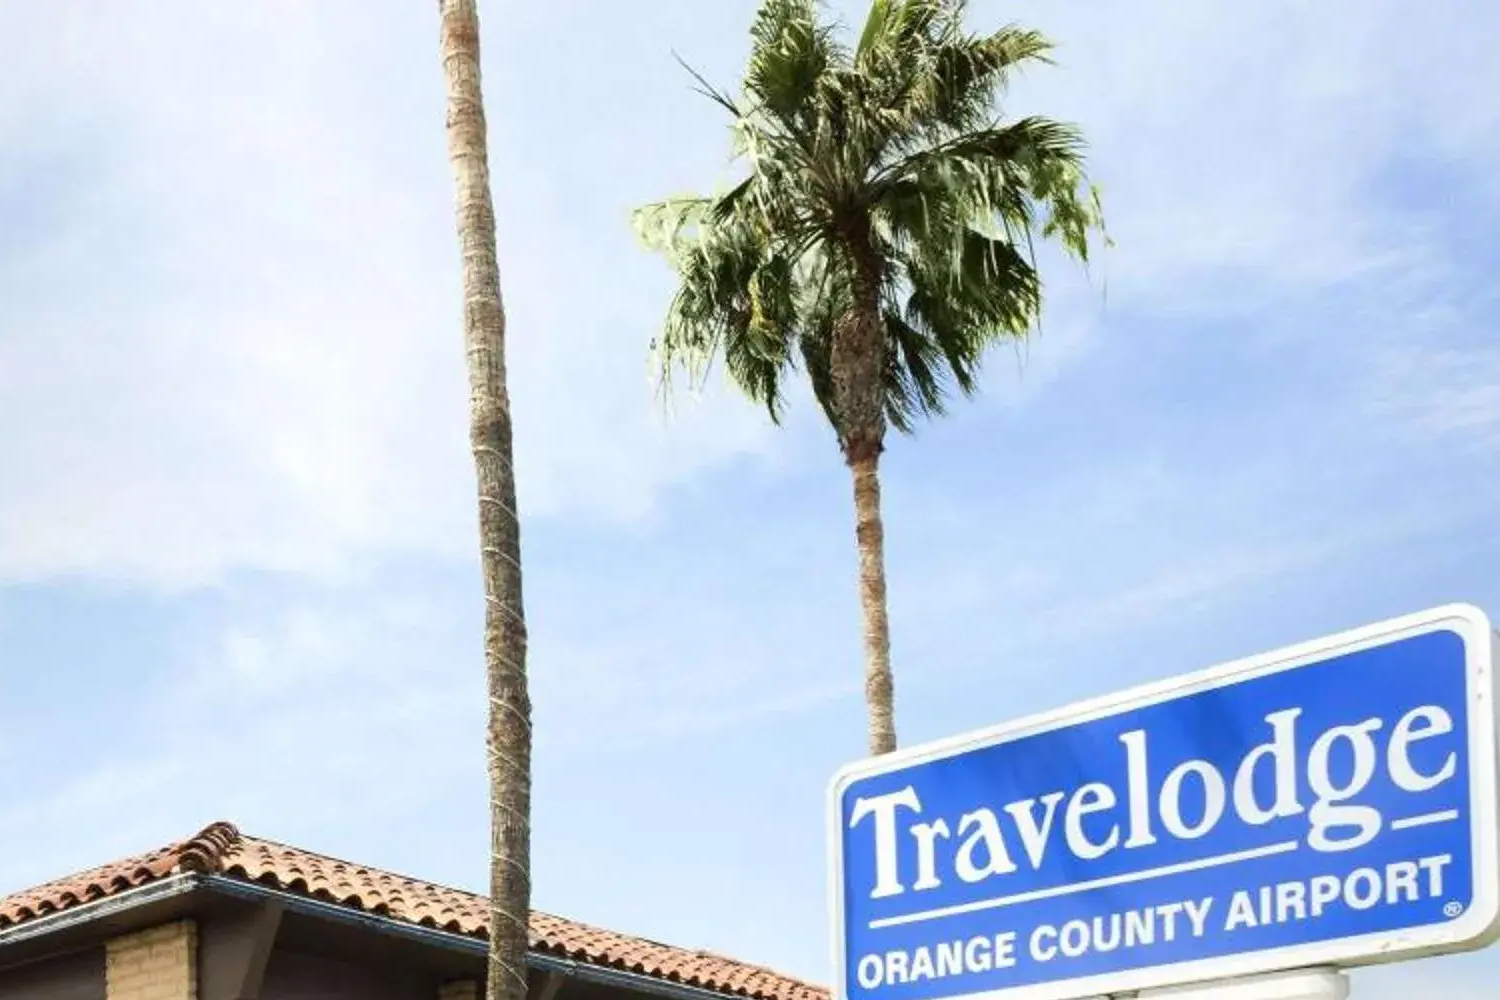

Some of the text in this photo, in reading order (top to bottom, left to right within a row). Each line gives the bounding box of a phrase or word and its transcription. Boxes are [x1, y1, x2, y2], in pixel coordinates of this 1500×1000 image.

[849, 705, 1456, 899] Travelodge
[857, 854, 1451, 990] ORANGE COUNTY AIRPORT
